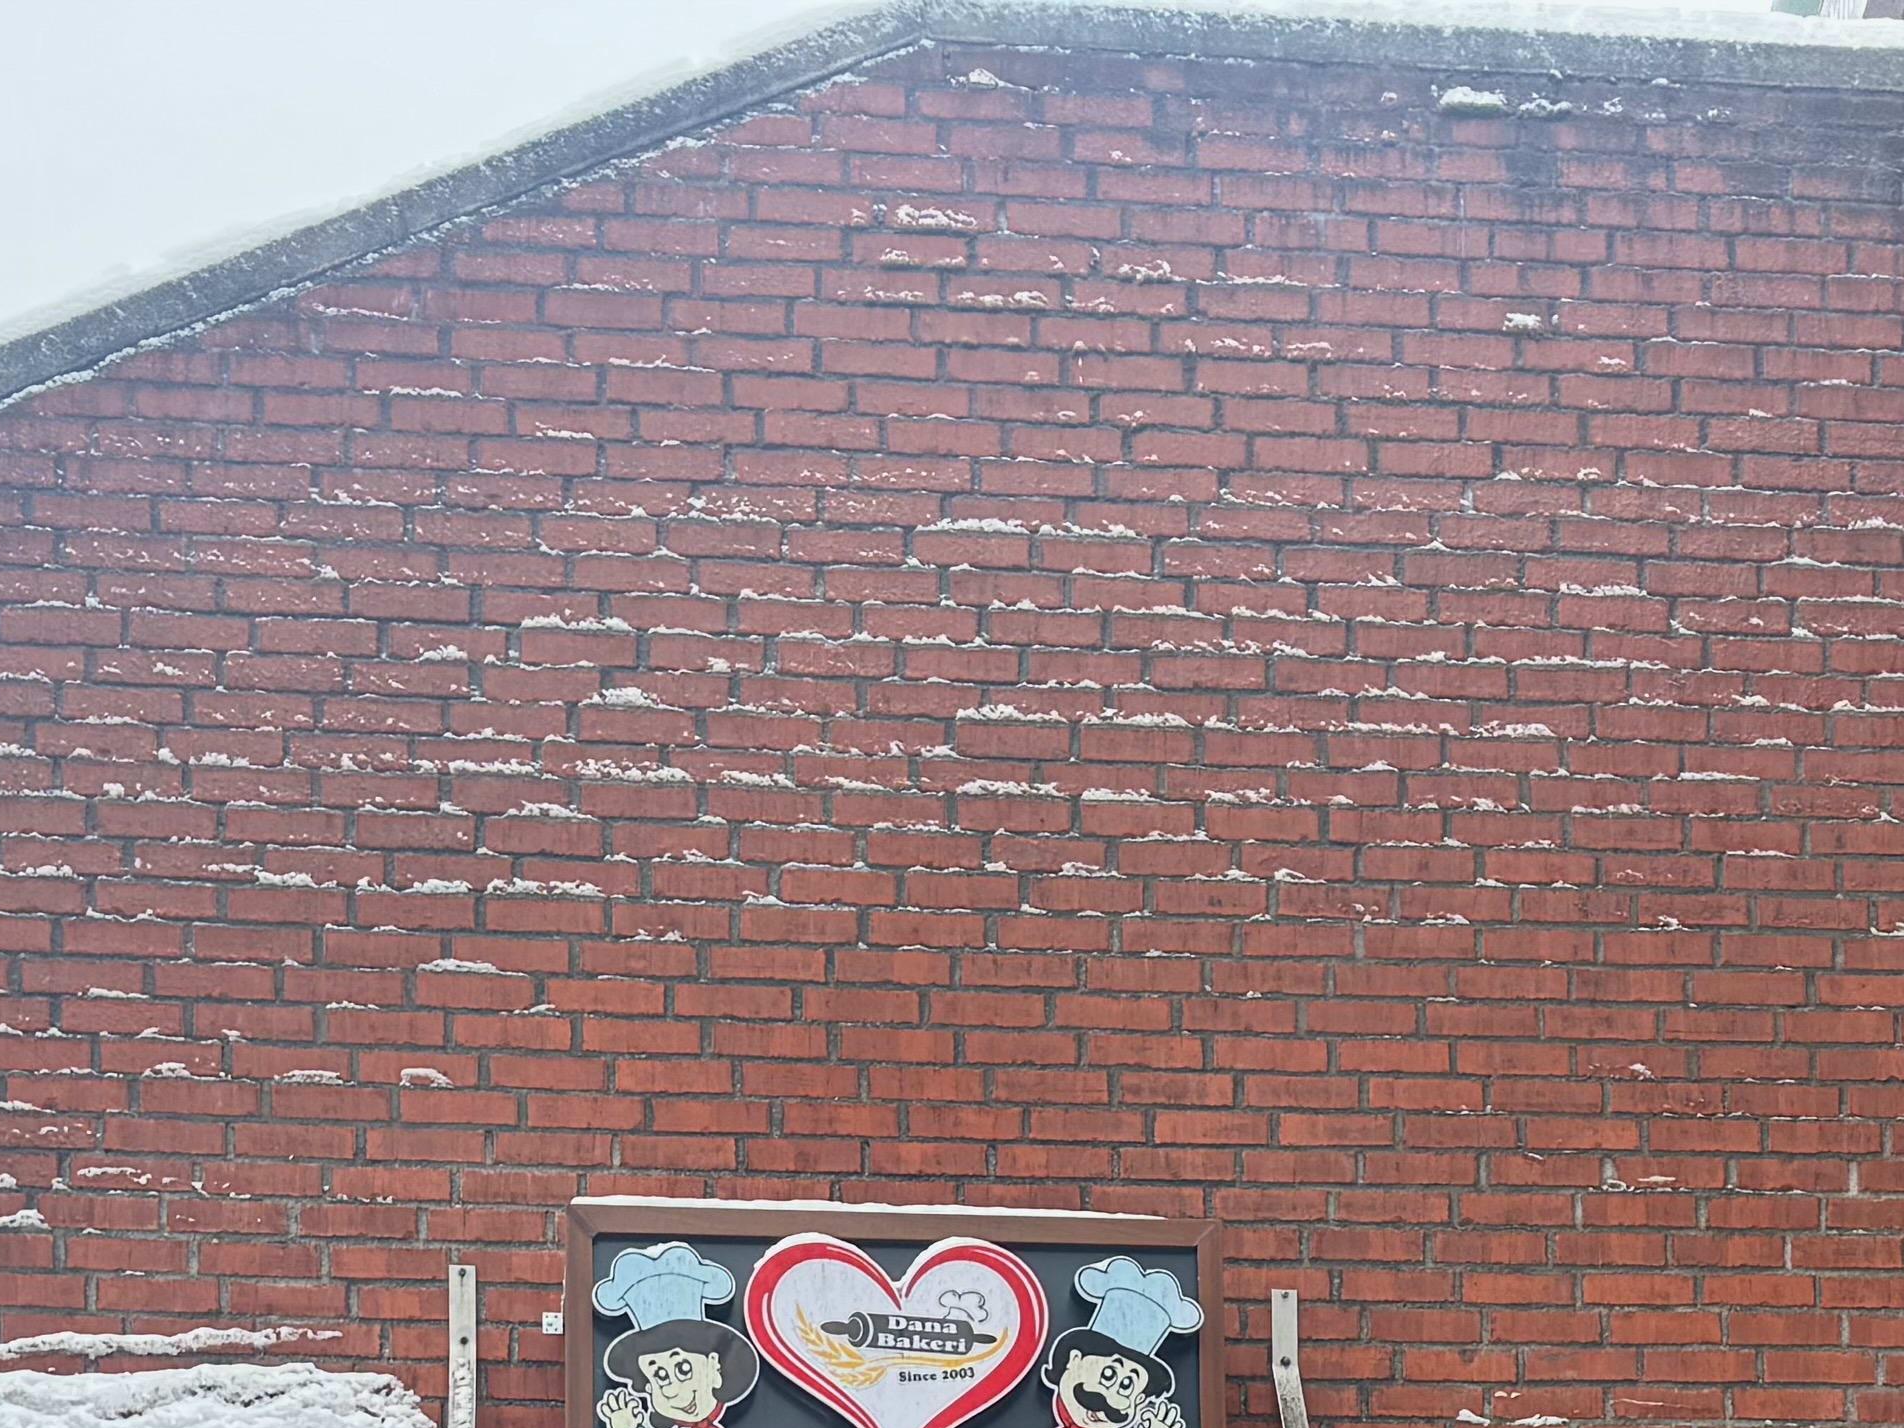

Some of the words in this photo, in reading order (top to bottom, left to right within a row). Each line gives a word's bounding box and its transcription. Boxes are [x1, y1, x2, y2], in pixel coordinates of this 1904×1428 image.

[887, 1315, 958, 1334] Dana
[876, 1333, 966, 1354] Bakeri
[898, 1368, 937, 1383] Since
[941, 1366, 976, 1382] 2003
